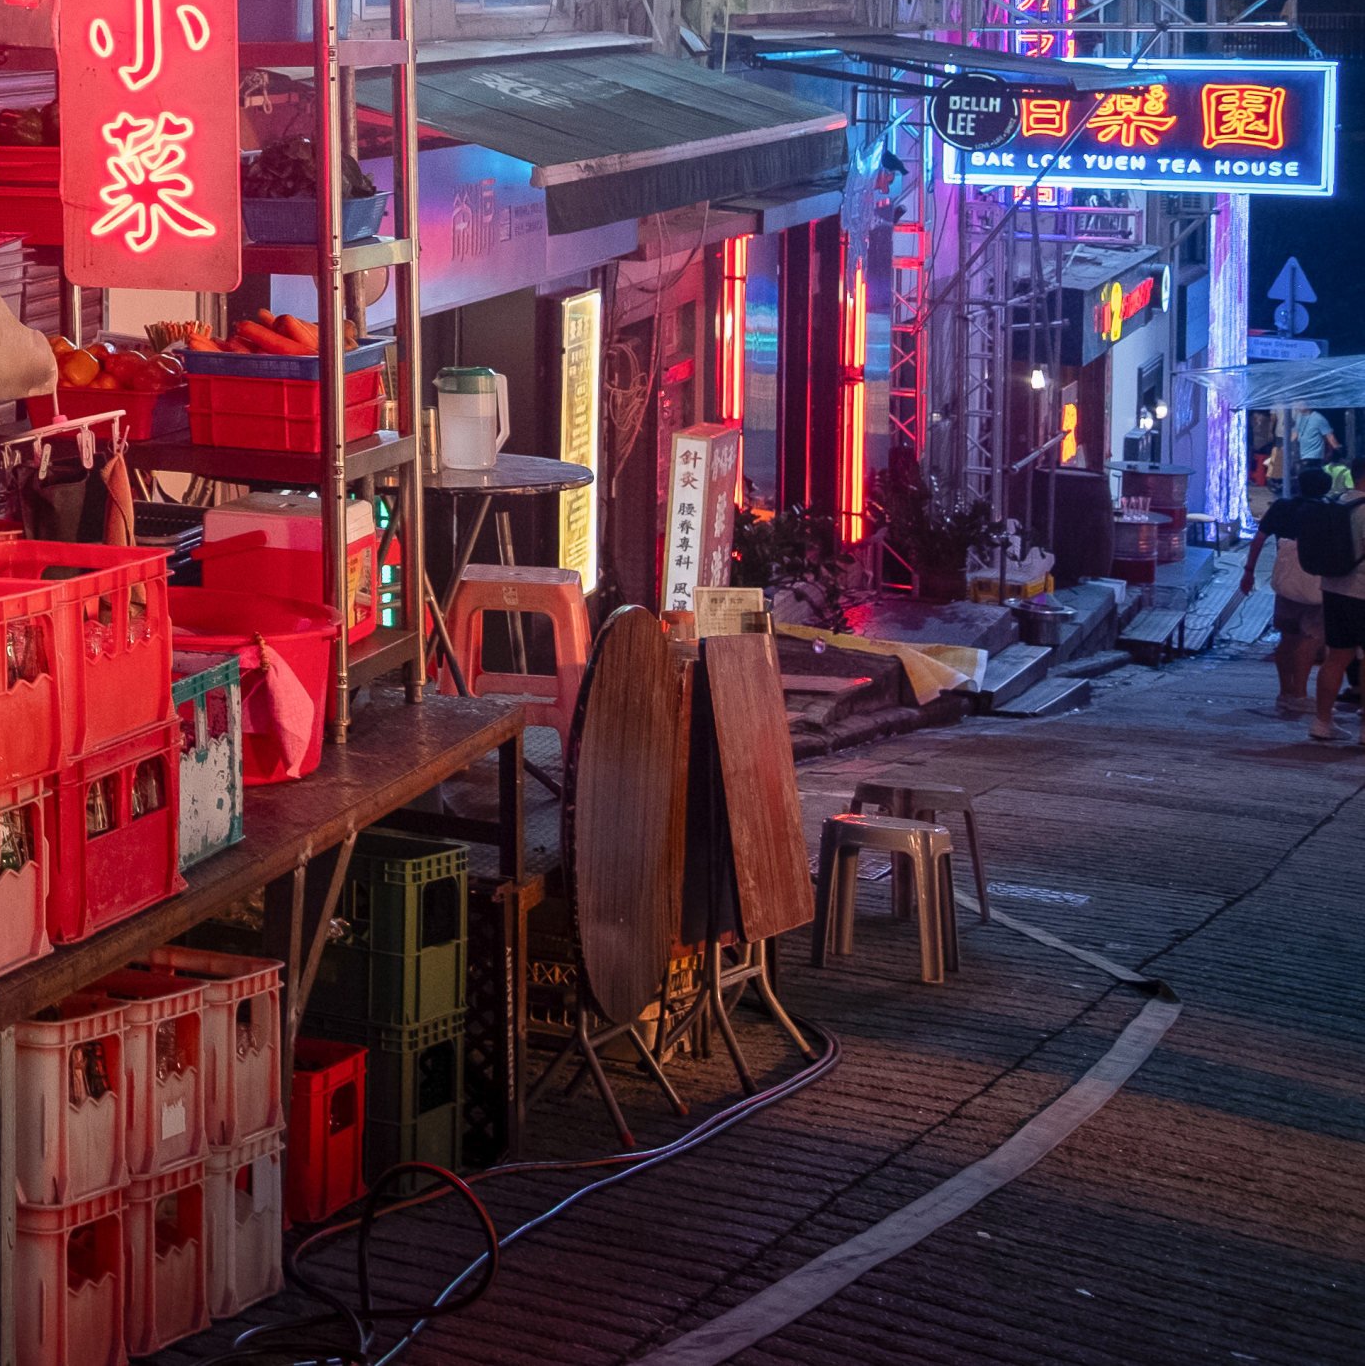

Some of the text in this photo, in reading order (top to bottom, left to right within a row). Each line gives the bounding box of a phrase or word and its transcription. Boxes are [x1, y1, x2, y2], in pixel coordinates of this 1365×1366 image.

[946, 112, 976, 136] LEE
[1021, 83, 1287, 149] 百樂園
[971, 151, 1015, 168] BAK
[1083, 154, 1147, 172] YUEN
[1157, 157, 1202, 174] TEA
[1214, 160, 1300, 178] HOUSE
[679, 449, 702, 490] 針灸
[674, 501, 697, 571] 腰脊專科
